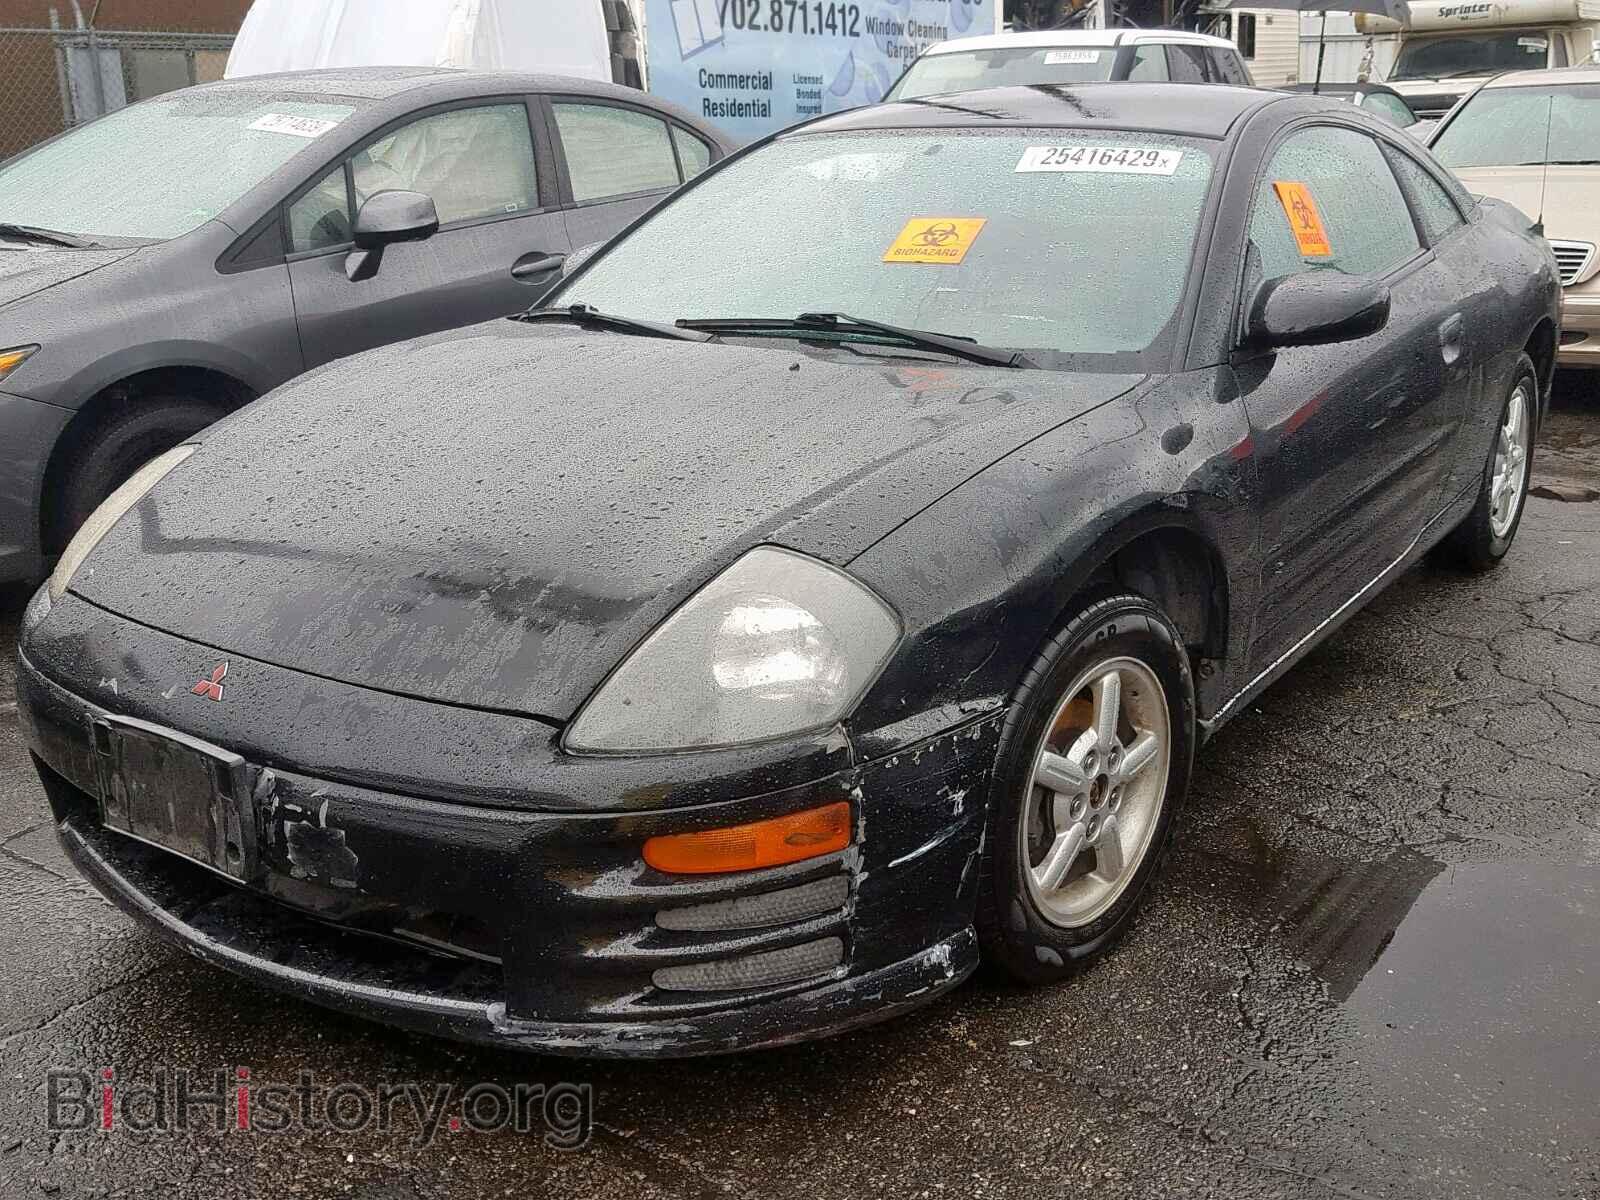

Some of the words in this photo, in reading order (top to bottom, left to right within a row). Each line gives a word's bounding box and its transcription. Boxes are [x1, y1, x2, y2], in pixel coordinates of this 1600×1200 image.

[719, 0, 860, 37] 702.871.1412
[1437, 3, 1492, 18] Sprinter
[864, 15, 905, 36] Window
[907, 20, 948, 40] Cleaning
[886, 40, 918, 61] Carpet
[698, 67, 773, 91] Commercial
[792, 73, 823, 85] Licensed
[795, 88, 821, 100] Bonded
[702, 97, 772, 118] Residential
[795, 103, 822, 114] Insured
[893, 247, 959, 257] BIOHAZARD
